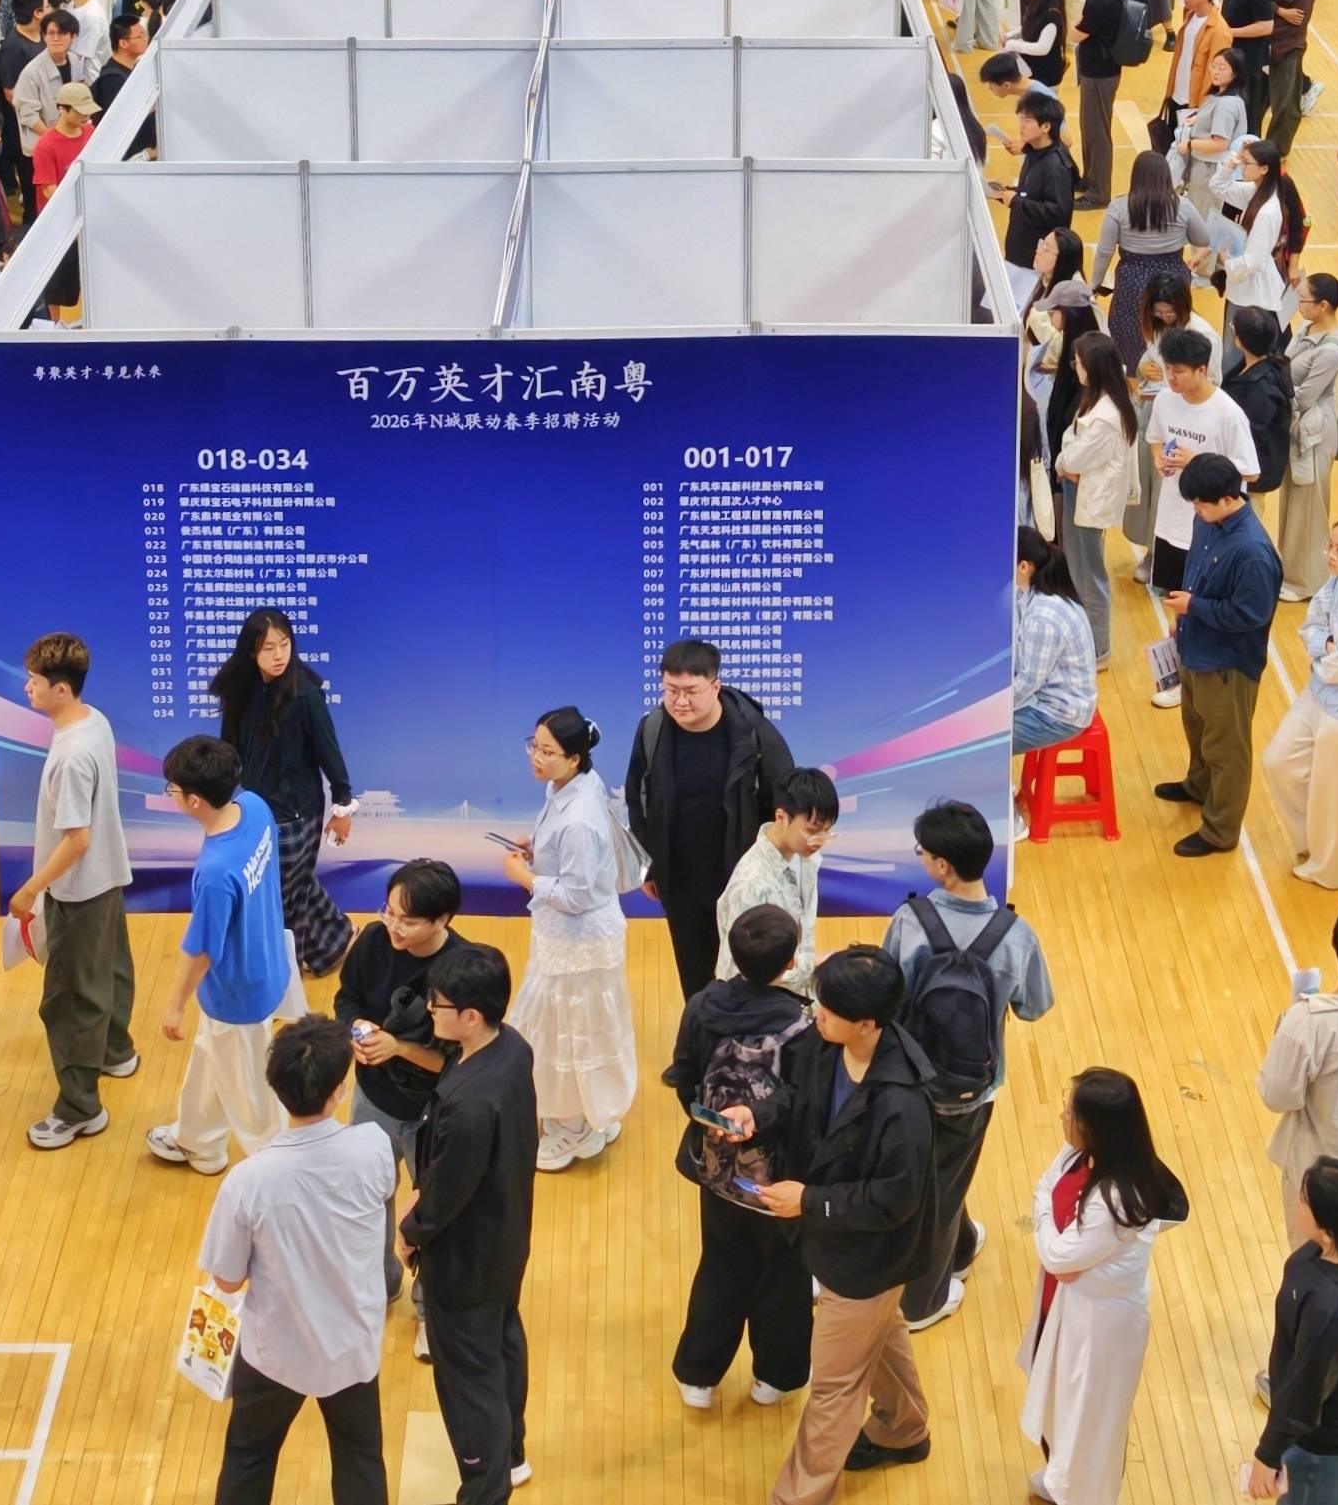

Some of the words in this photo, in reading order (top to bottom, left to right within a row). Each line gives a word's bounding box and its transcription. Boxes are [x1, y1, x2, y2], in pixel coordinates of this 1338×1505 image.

[33, 364, 162, 381] 粤聚英才·粤见未来
[336, 359, 654, 404] 百万英才汇南粤
[370, 411, 622, 430] 2026年N城联动春季招聘活动
[1168, 425, 1206, 444] wassup
[197, 448, 310, 470] 018-034
[683, 445, 794, 468] 001-017
[142, 483, 164, 493] 018
[643, 483, 663, 492] 001
[143, 498, 164, 507] 019
[643, 497, 664, 506] 002
[144, 512, 165, 521] 020
[643, 511, 664, 520] 003
[144, 526, 165, 535] 021
[643, 526, 664, 535] 004
[145, 541, 166, 550] 022
[643, 540, 664, 549] 005
[146, 555, 167, 564] 023
[643, 555, 664, 563] 006
[146, 569, 167, 578] 024
[643, 569, 664, 578] 007
[147, 583, 168, 592] 025
[643, 584, 664, 592] 008
[148, 597, 169, 606] 026
[643, 598, 664, 606] 009
[149, 611, 170, 620] 027
[643, 612, 664, 621] 010
[149, 626, 171, 634] 028
[643, 626, 664, 635] 011
[150, 640, 171, 648] 029
[643, 640, 664, 649] 012
[151, 654, 172, 662] 030
[151, 667, 172, 676] 031
[152, 681, 173, 690] 032
[153, 695, 174, 704] 033
[153, 708, 174, 718] 034
